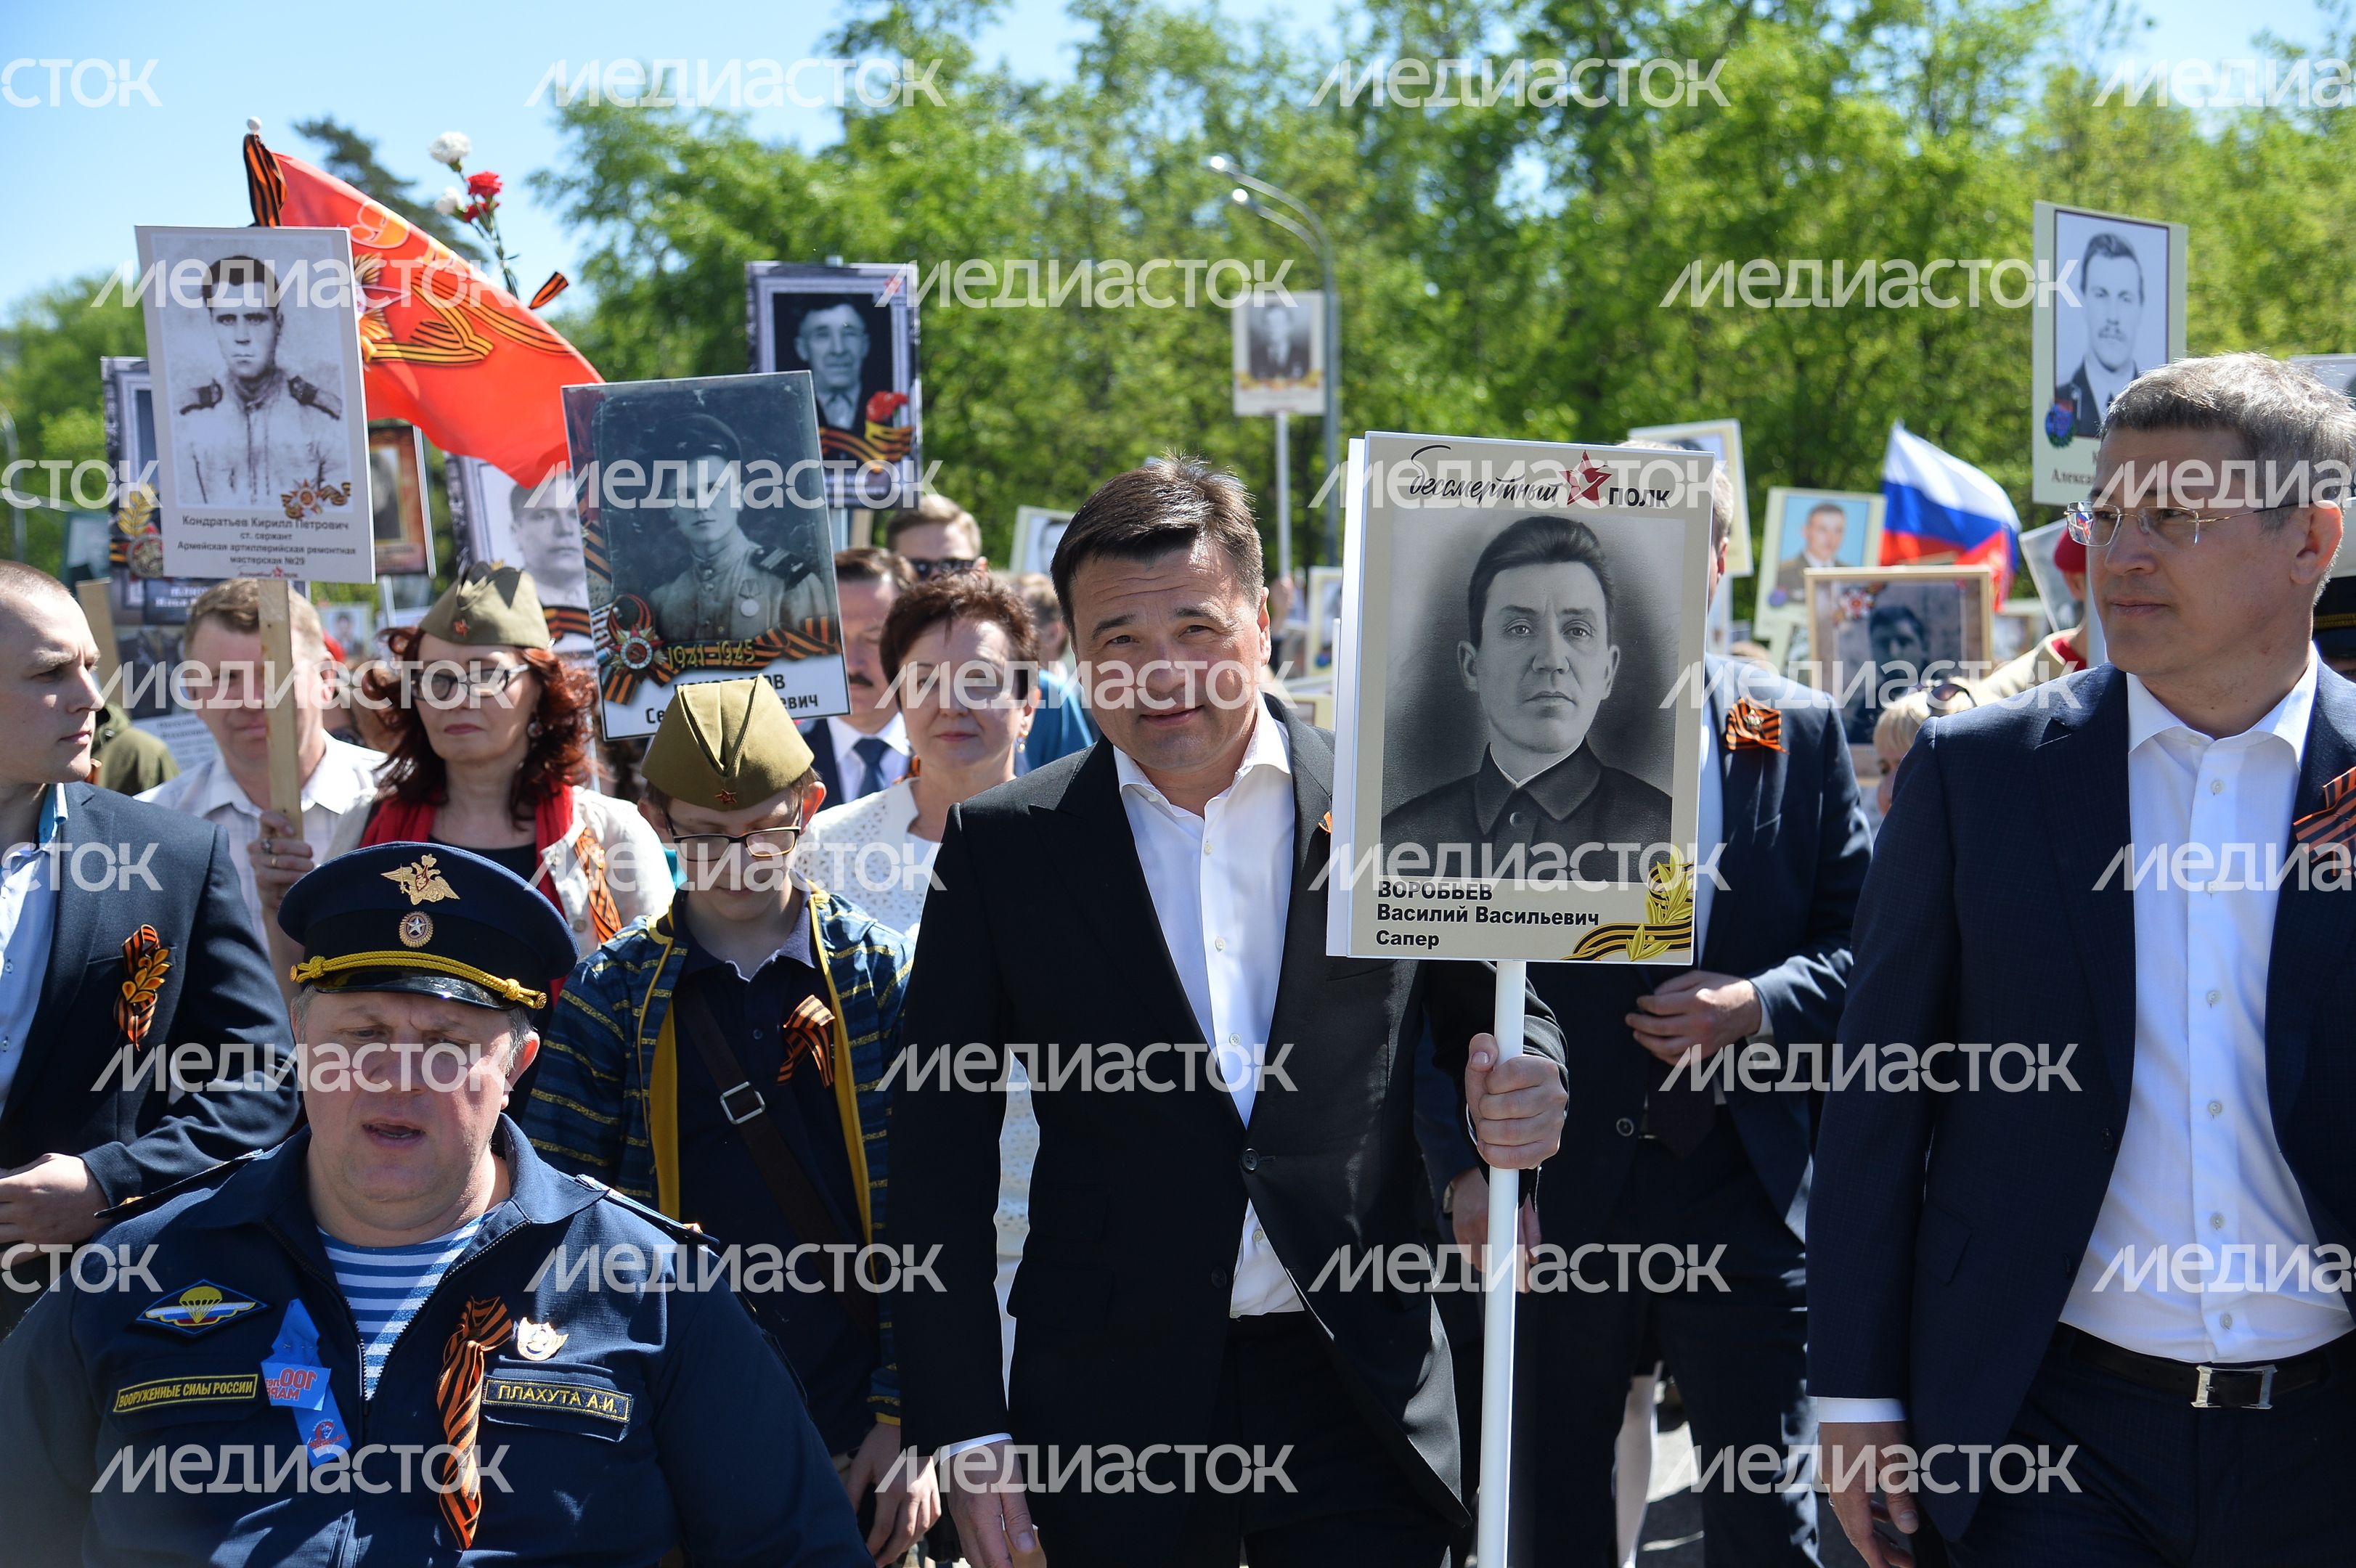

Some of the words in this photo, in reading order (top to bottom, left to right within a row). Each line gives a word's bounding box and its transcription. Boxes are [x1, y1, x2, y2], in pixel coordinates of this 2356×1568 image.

[182, 515, 248, 528] Кондратьев
[251, 517, 292, 529] Кирилл
[295, 518, 349, 531] Петрович
[255, 532, 292, 541] сержант
[667, 639, 756, 670] 1941-1945
[1378, 881, 1493, 900] ВОРОБЬЕВ
[1377, 903, 1468, 923] Василий
[1475, 906, 1599, 926] Васильевич
[1376, 930, 1439, 950] Сапер
[118, 1384, 181, 1408] ВООРУЖЕННЫЕ
[182, 1383, 212, 1397] СИЛЫ
[213, 1381, 253, 1395] РОССИИ
[497, 1385, 582, 1406] ПЛАХУТА
[587, 1394, 617, 1413] А.И.
